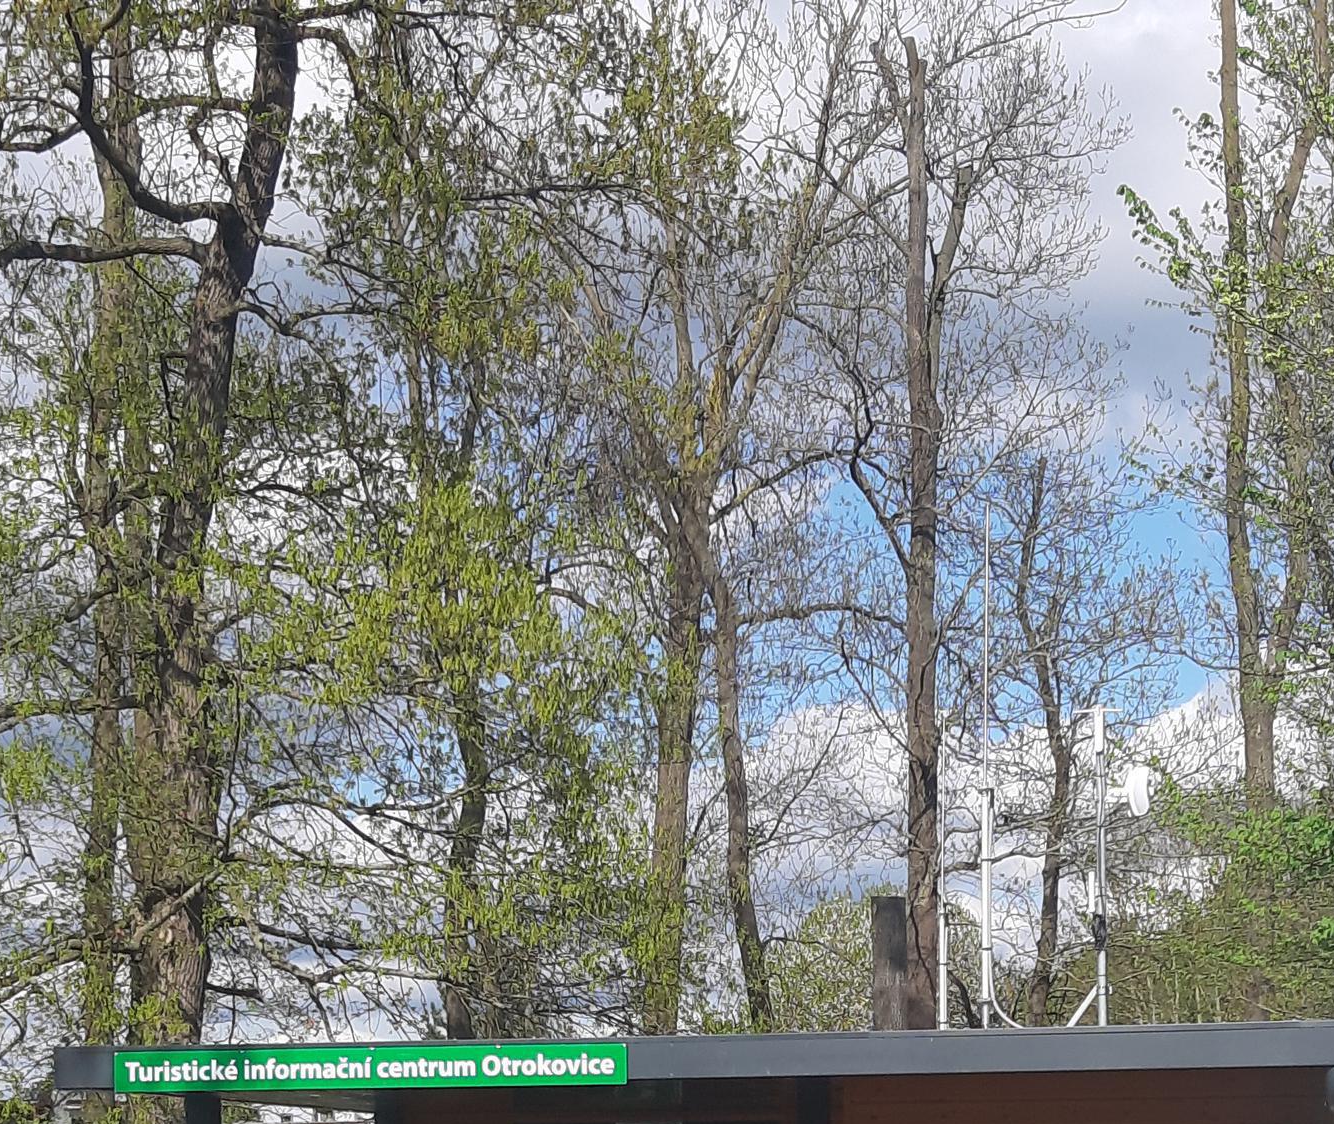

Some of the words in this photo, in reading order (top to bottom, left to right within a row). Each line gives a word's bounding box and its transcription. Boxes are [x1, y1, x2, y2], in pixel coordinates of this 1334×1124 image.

[125, 1059, 238, 1083] Turistické
[244, 1057, 371, 1081] informační
[377, 1059, 476, 1079] centrum
[482, 1054, 615, 1077] Otrokovice
